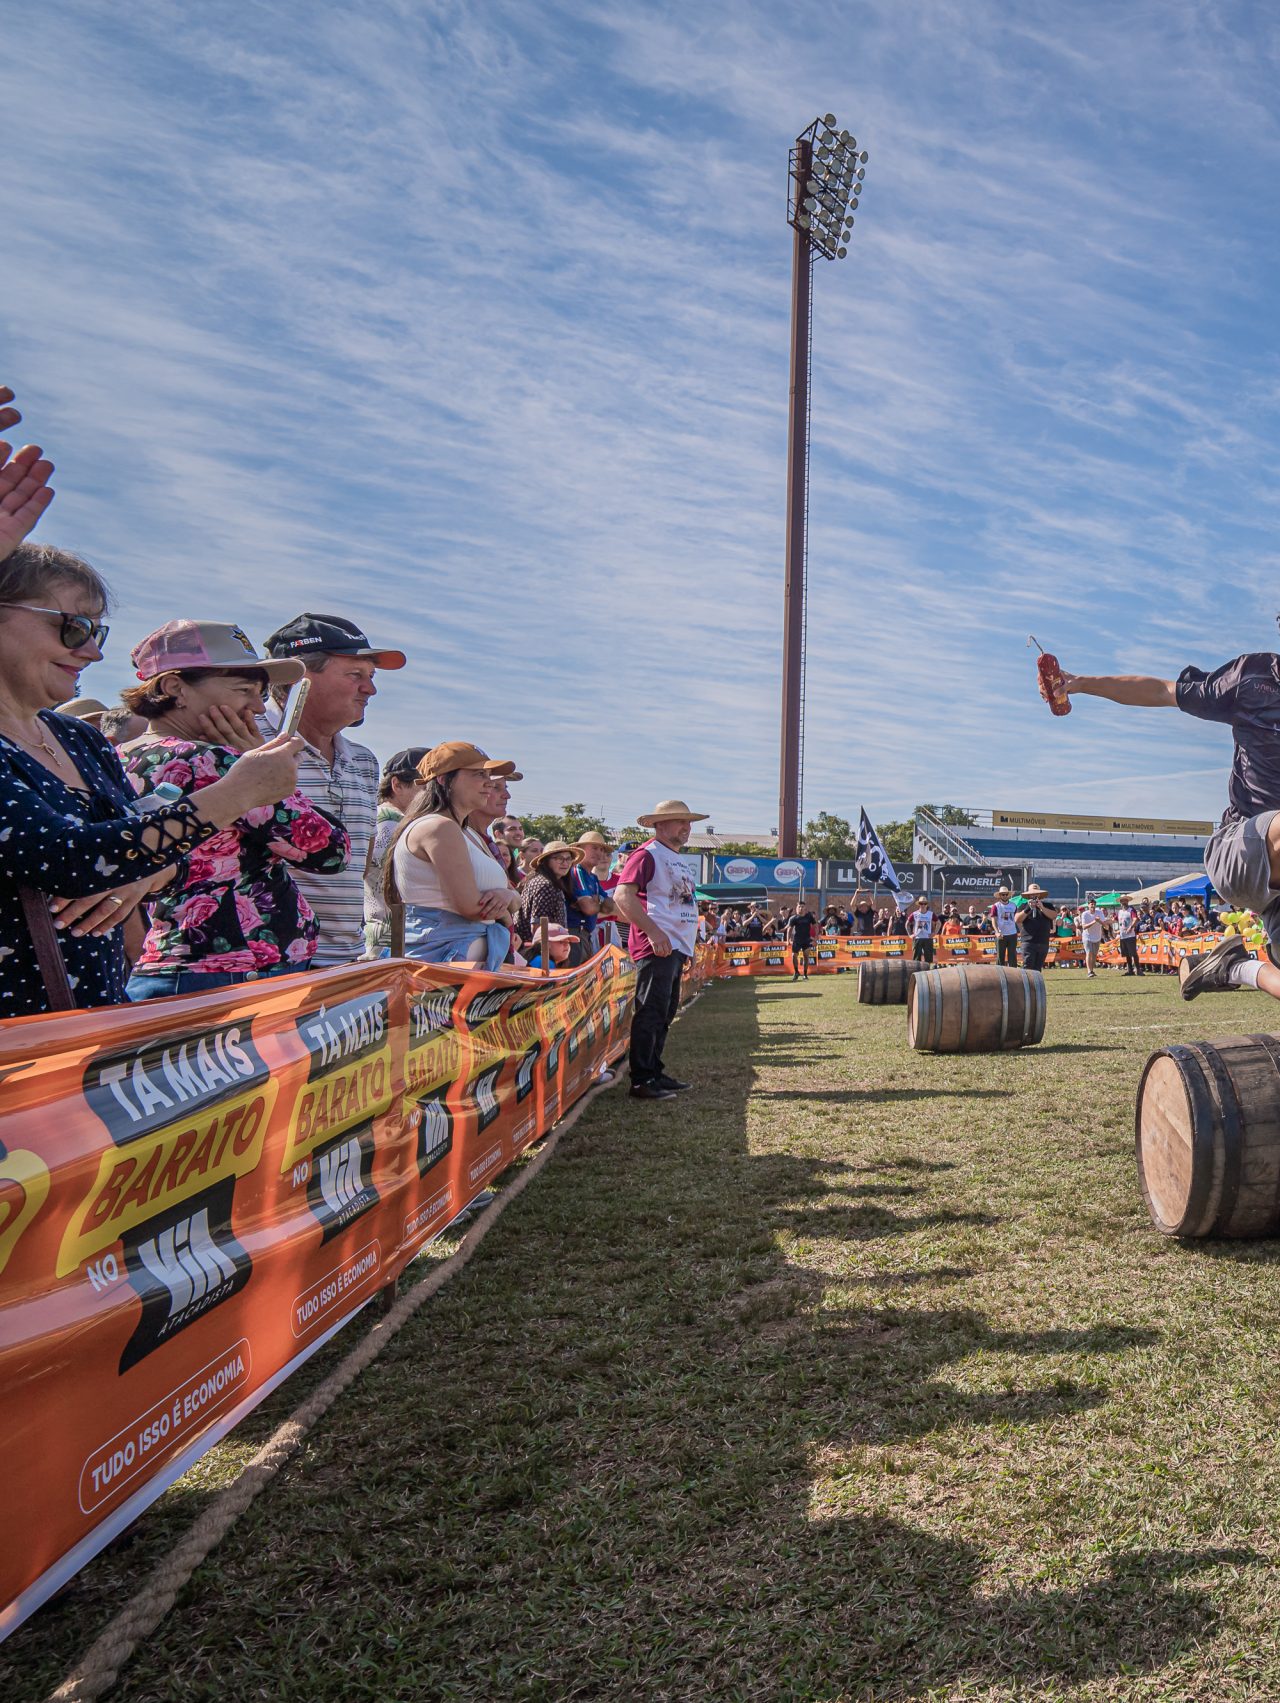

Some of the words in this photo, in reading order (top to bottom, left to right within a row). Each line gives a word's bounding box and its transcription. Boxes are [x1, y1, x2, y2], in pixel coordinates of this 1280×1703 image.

[290, 636, 322, 649] FARBEN
[1009, 816, 1046, 826] MULTIMÓVEIS
[1121, 822, 1155, 831] MULTIMÓVEIS
[953, 877, 1002, 887] ANDERLE
[427, 992, 455, 1031] MAIS
[307, 1003, 341, 1066] TÁ
[340, 1003, 383, 1055] MAIS
[100, 1039, 174, 1121] TÁ
[162, 1028, 254, 1102] MAIS
[294, 1057, 385, 1146] BARATO
[408, 1110, 420, 1130] NO
[78, 1096, 265, 1236] BARATO
[292, 1161, 309, 1188] NO
[338, 1193, 370, 1226] ATACADISTA
[87, 1254, 118, 1291] NO
[296, 1295, 318, 1326] TUDO
[320, 1282, 337, 1308] ISSO
[337, 1273, 344, 1293] É
[343, 1250, 377, 1289] ECONOMIA
[158, 1279, 234, 1337] ATACADISTA
[92, 1443, 135, 1492] TUDO
[139, 1411, 170, 1454] ISSO
[173, 1400, 182, 1428] É
[184, 1355, 244, 1415] ECONOMIA
